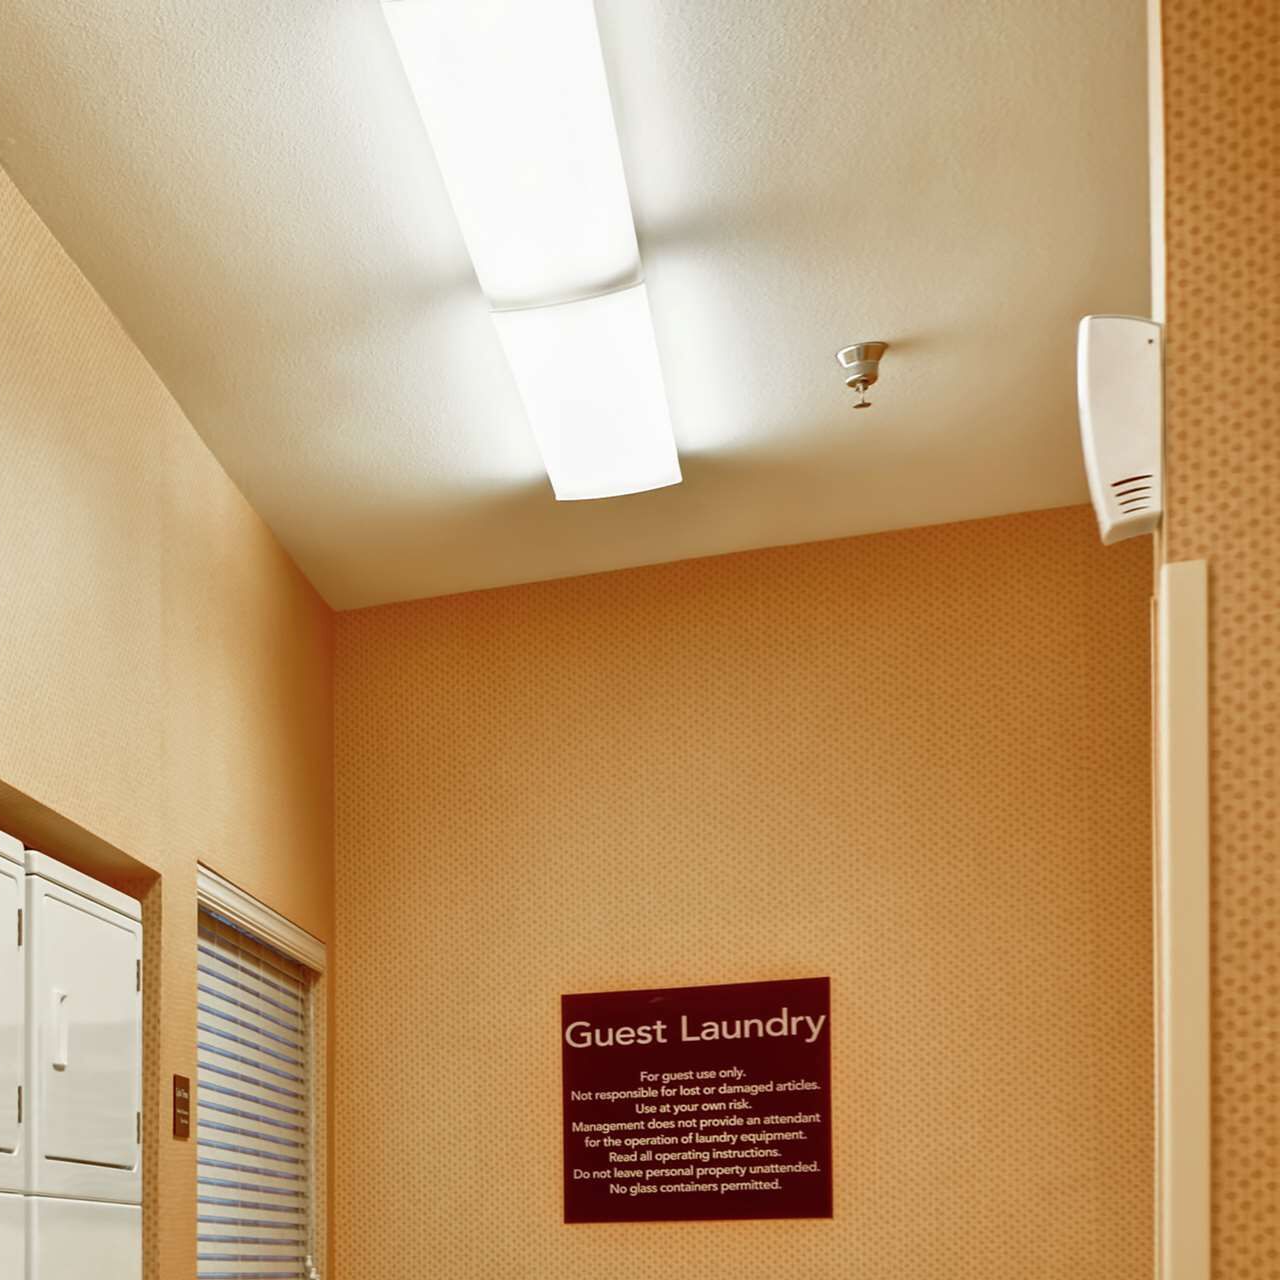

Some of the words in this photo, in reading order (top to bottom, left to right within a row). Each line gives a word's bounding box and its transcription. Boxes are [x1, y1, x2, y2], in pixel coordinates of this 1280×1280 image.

[565, 1020, 668, 1048] Guest
[681, 1007, 826, 1043] Laundry
[640, 1071, 660, 1082] For
[662, 1070, 694, 1083] guest
[696, 1070, 716, 1080] use
[718, 1067, 746, 1080] only.
[571, 1090, 592, 1102] Not
[595, 1088, 658, 1102] responsible
[661, 1086, 678, 1097] for
[680, 1086, 701, 1096] lost
[703, 1086, 716, 1095] or
[718, 1082, 773, 1097] damaged
[776, 1080, 821, 1092] articles.
[636, 1104, 657, 1114] Use
[659, 1104, 671, 1113] at
[673, 1102, 700, 1115] your
[701, 1102, 726, 1112] own
[728, 1100, 752, 1110] risk.
[572, 1120, 645, 1134] Management
[648, 1118, 675, 1130] does
[678, 1118, 698, 1128] not
[700, 1116, 744, 1130] provide
[746, 1116, 760, 1125] an
[763, 1113, 821, 1124] attendant
[584, 1136, 601, 1148] for
[604, 1136, 622, 1147] the
[624, 1134, 678, 1149] operation
[681, 1134, 693, 1144] of
[695, 1131, 738, 1146] laundry
[740, 1130, 808, 1144] equipment.
[609, 1152, 637, 1162] Read
[640, 1150, 652, 1161] all
[655, 1149, 710, 1164] operating
[712, 1148, 782, 1159] instructions.
[573, 1169, 590, 1180] Do
[592, 1168, 612, 1178] not
[614, 1167, 643, 1178] leave
[645, 1165, 694, 1180] personal
[696, 1166, 747, 1178] property
[749, 1162, 820, 1174] unattended.
[610, 1184, 627, 1194] No
[630, 1182, 658, 1196] glass
[660, 1180, 718, 1192] containers
[720, 1179, 782, 1194] permitted.
